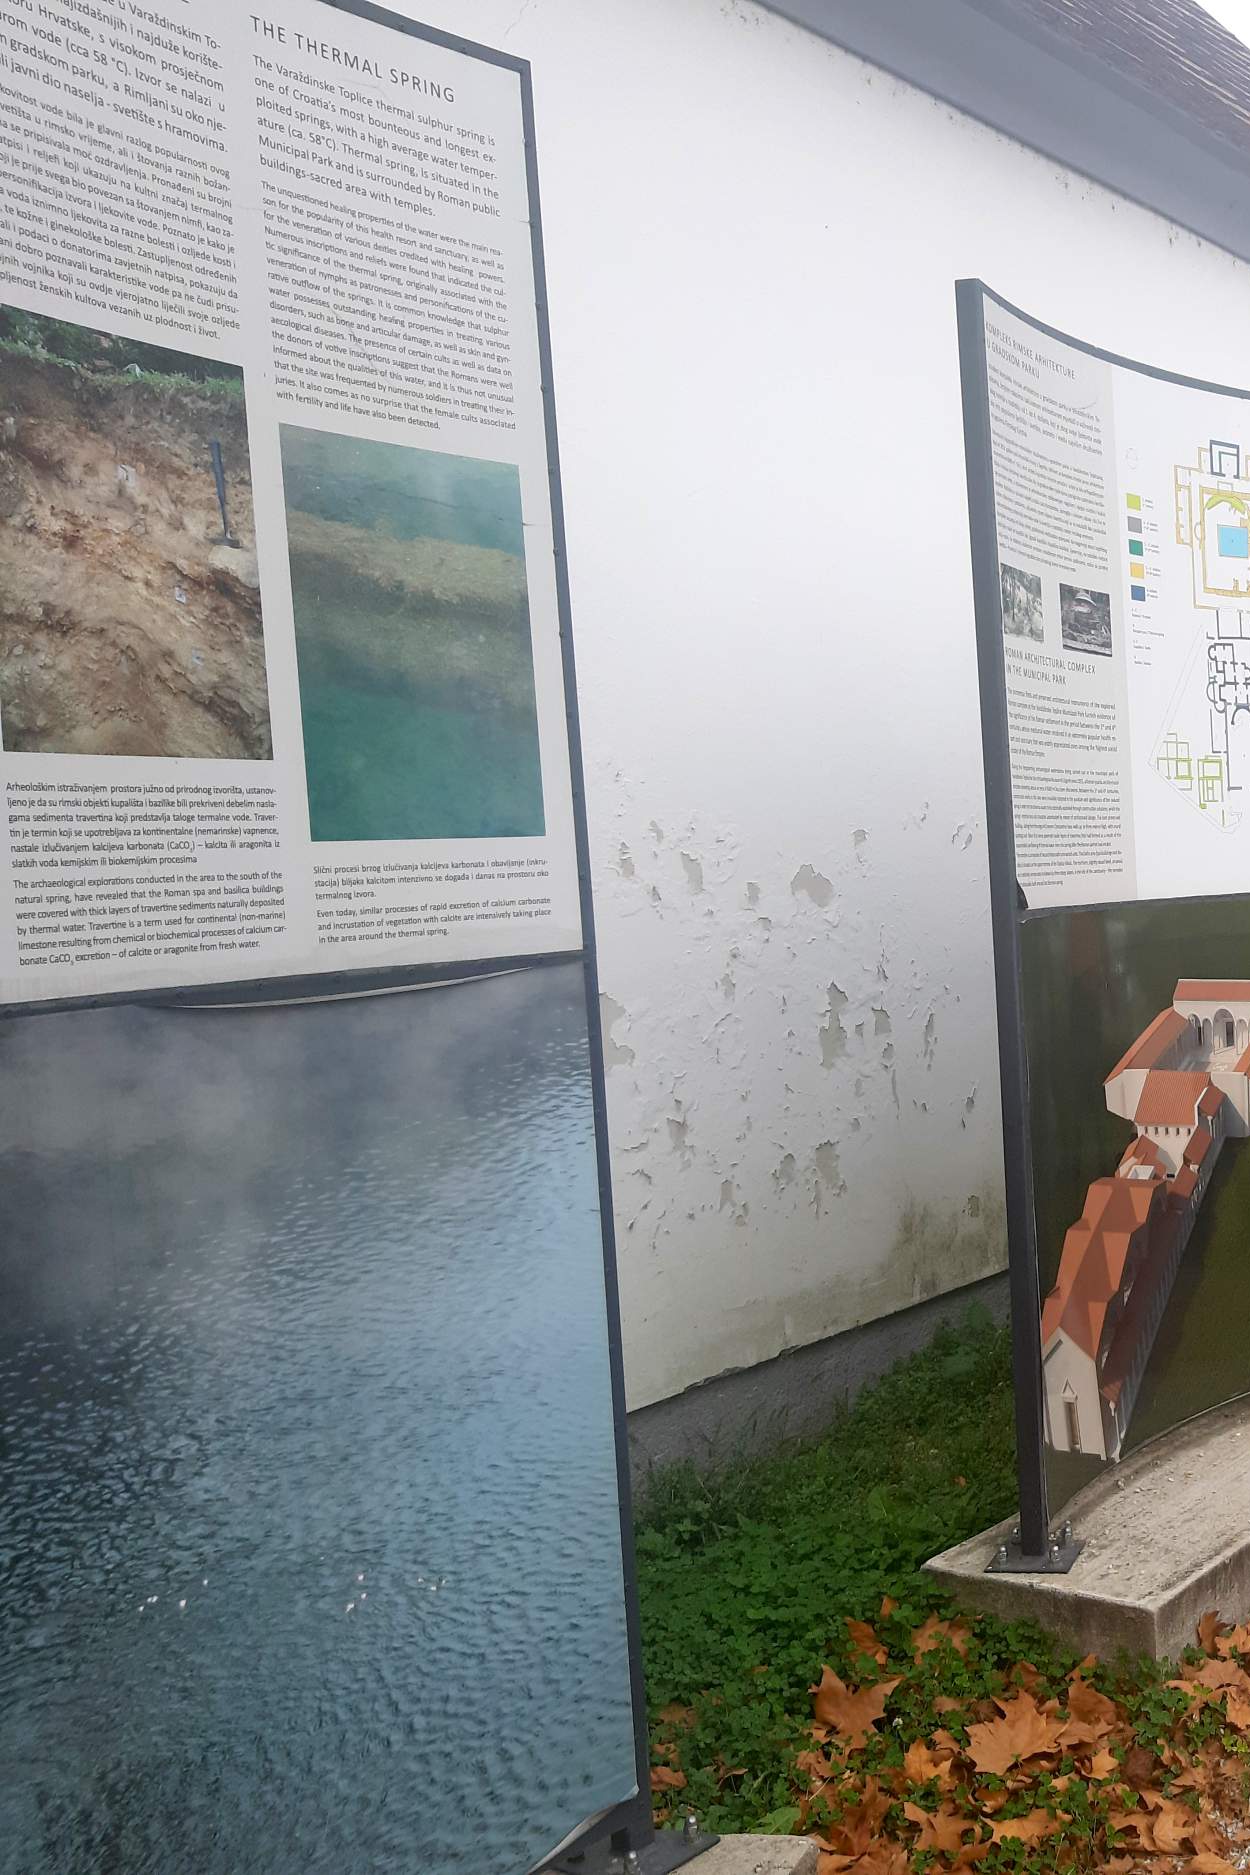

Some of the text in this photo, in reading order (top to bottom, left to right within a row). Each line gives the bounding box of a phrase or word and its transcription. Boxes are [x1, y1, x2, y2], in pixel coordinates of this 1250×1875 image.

[39, 4, 224, 92] Hrvatske, s visokom prosječnom
[118, 1, 125, 10] u
[129, 2, 201, 43] Varaždinskim
[204, 35, 221, 49] To-
[137, 29, 180, 55] najduže
[182, 45, 222, 70] korište-
[250, 15, 454, 102] THE THERMAL SPRING
[10, 38, 69, 71] gradskom
[72, 65, 108, 89] parku,
[113, 82, 119, 92] a
[124, 84, 168, 111] Rimljani
[171, 105, 183, 117] su
[185, 110, 204, 124] oko
[207, 117, 226, 131] nje-
[10, 57, 228, 152] javni dio naselja svetište s hramovima.
[31, 25, 62, 47] vode
[66, 38, 89, 58] (cca
[93, 50, 108, 66] 58
[135, 68, 162, 87] Izvor
[166, 82, 177, 94] se
[181, 89, 211, 107] nalazi
[219, 103, 225, 112] u
[252, 54, 495, 146] The Varaždinske Toplice thermal sulphur spring is
[254, 77, 496, 163] one of Croatia's most bounteous and longest ex-
[256, 96, 497, 180] ploited springs, with a high average water temper-
[257, 117, 285, 133] ature
[288, 124, 306, 140] (ca.
[341, 143, 382, 165] Thermal
[386, 159, 418, 177] spring,
[421, 168, 428, 178] is
[431, 172, 469, 191] situated
[472, 183, 481, 194] in
[483, 187, 499, 199] the
[259, 134, 500, 217] Municipal Park and is surrounded by Roman public
[260, 153, 435, 216] buildings-sacred area with temples.
[109, 303, 141, 318] vezanih
[143, 313, 153, 322] uz
[155, 315, 192, 332] plodnost
[198, 325, 220, 339] život.
[1067, 661, 1096, 674] COMPLEX
[13, 880, 29, 888] The
[30, 877, 86, 889] archaeological
[87, 876, 134, 887] explorations
[136, 874, 175, 884] conducted
[177, 874, 184, 882] in
[185, 874, 198, 882] the
[226, 873, 238, 881] the
[240, 872, 260, 880] south
[261, 871, 269, 879] of
[270, 871, 282, 879] the
[16, 898, 285, 920] were covered with thick layers of travertine sediments naturally deposited
